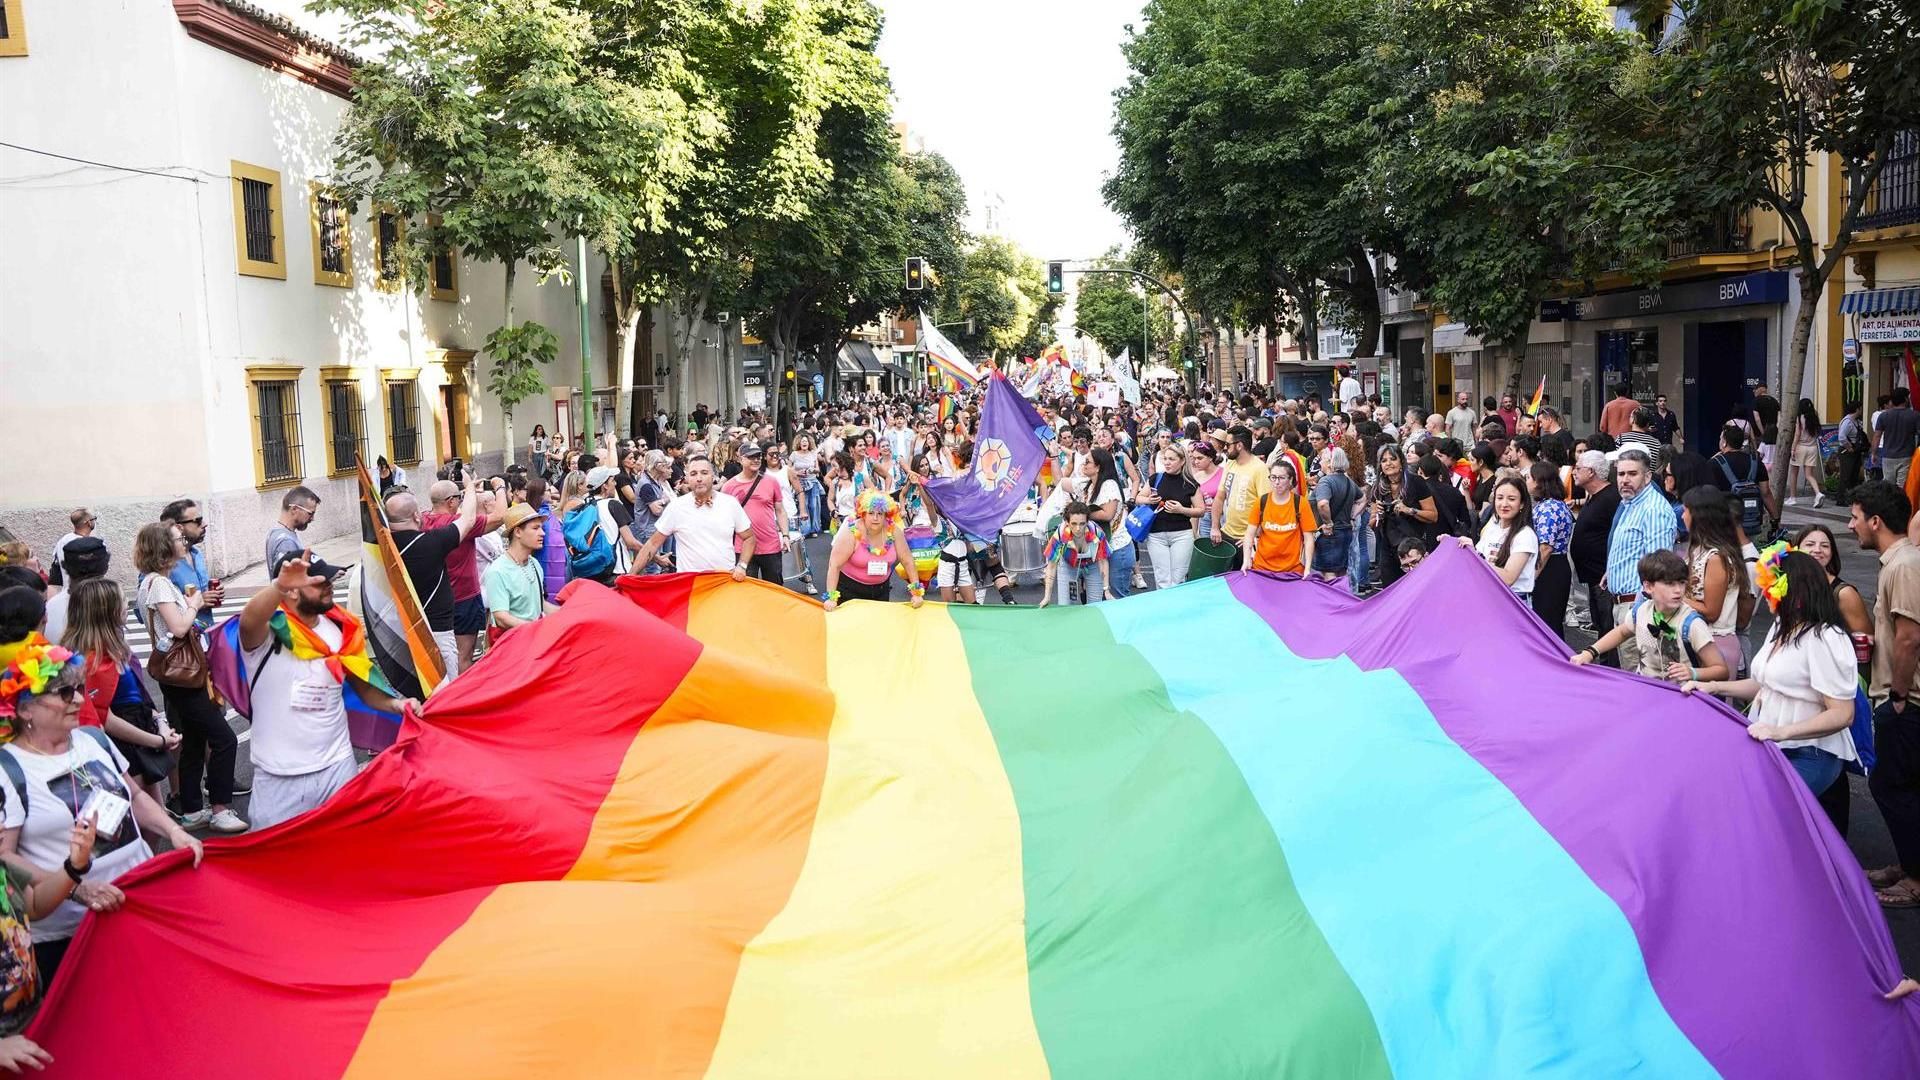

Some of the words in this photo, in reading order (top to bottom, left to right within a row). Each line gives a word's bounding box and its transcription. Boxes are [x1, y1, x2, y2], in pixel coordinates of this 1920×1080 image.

[1719, 280, 1750, 300] BBVA
[1575, 301, 1595, 315] BBVA
[1639, 293, 1663, 309] BBVA
[1862, 321, 1876, 329] ART.
[1877, 320, 1886, 329] DE
[1903, 329, 1920, 339] DRO
